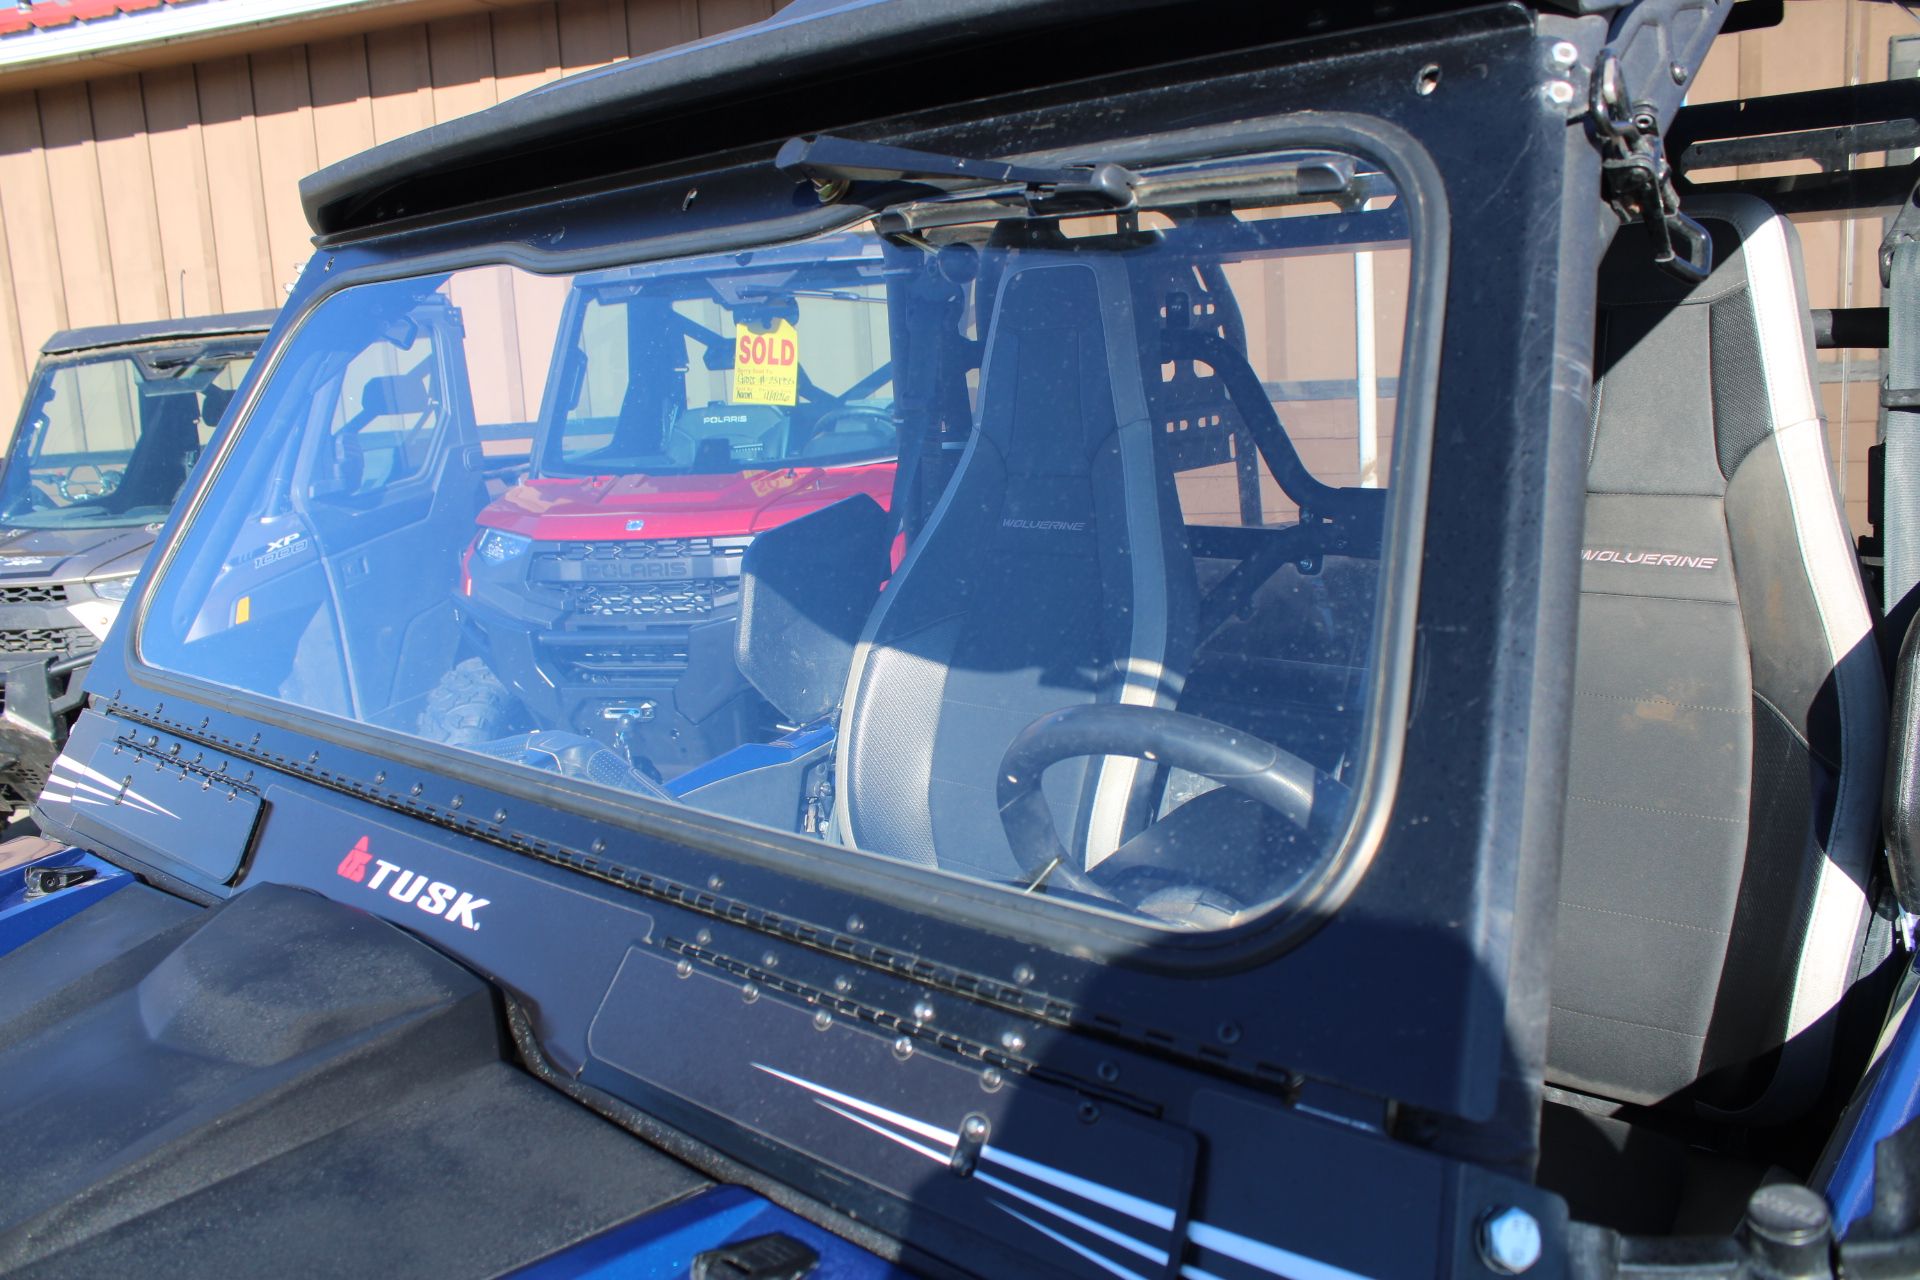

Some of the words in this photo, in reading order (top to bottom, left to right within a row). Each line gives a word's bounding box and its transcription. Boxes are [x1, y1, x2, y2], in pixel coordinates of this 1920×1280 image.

[739, 335, 795, 366] SOLD
[703, 415, 747, 424] POLARIS
[1002, 518, 1087, 531] WOLVERINE
[266, 533, 300, 553] XP
[254, 538, 308, 569] 1000
[1581, 549, 1718, 569] WOLVERINE
[584, 561, 688, 579] POLARIS
[367, 859, 491, 930] TUSK
